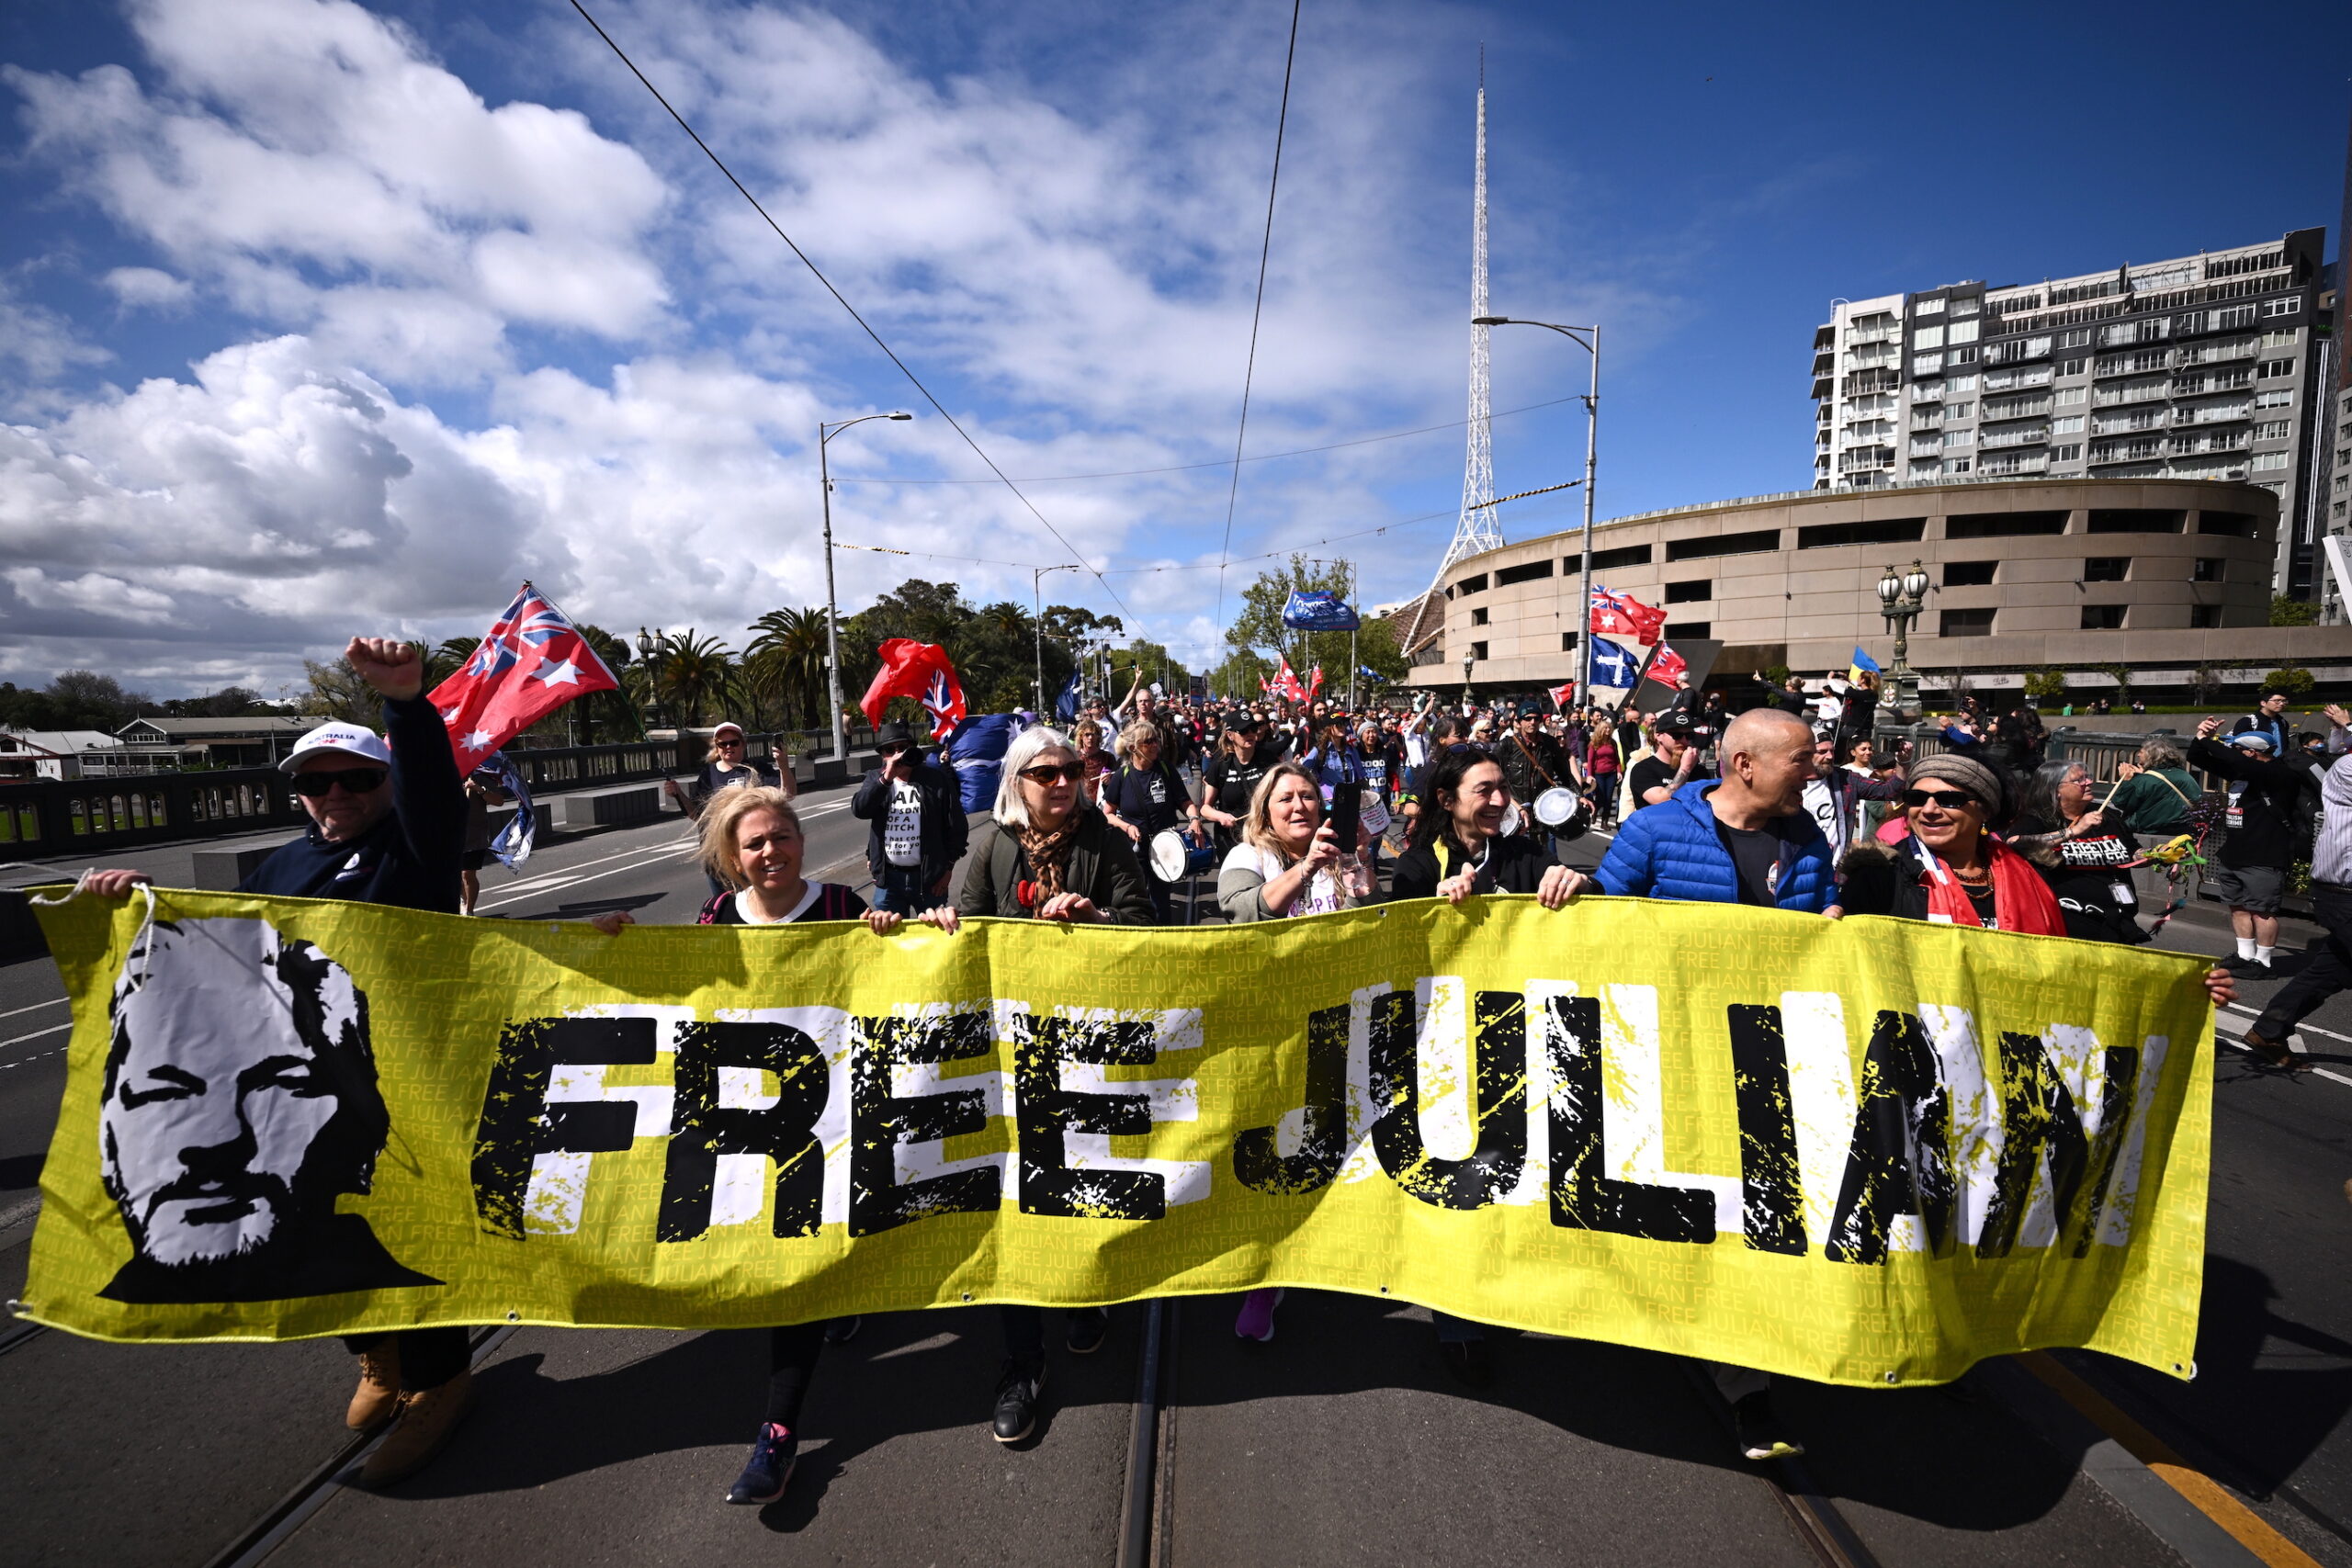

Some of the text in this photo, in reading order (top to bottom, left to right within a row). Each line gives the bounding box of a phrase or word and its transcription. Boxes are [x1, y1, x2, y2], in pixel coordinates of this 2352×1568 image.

[1367, 777, 1386, 786] AD
[891, 790, 922, 805] AN
[345, 914, 425, 938] JULIAN
[436, 925, 477, 945] FREE
[568, 937, 606, 953] FREE
[611, 939, 661, 953] JULIAN
[665, 937, 703, 953] FREE
[771, 937, 813, 954] FREE
[820, 933, 883, 952] JULIAN
[1035, 923, 1365, 957] JULIAN JULIAN FREE JULIAN FREE
[1684, 931, 1752, 952] JULIAN
[1758, 935, 1802, 954] FREE
[385, 939, 435, 961] FREE
[442, 943, 518, 966] JULIAN
[573, 953, 635, 970] JULIAN
[636, 954, 672, 972] FREE
[678, 956, 730, 973] JULIAN
[736, 956, 775, 974] FREE
[781, 953, 844, 974] JULIAN
[1059, 956, 1103, 976] FREE
[1106, 959, 1169, 976] JULIAN
[1176, 959, 1219, 975] FREE
[1224, 953, 1287, 975] JULIAN
[1296, 944, 1332, 964] FREE
[1338, 936, 1391, 959] JULIAN
[773, 975, 816, 992] FREE
[821, 969, 882, 988] JULIAN
[1035, 972, 1094, 991] JULIAN
[1098, 976, 1140, 994] FREE
[1147, 976, 1210, 994] JULIAN
[1216, 976, 1259, 992] FREE
[1263, 967, 1325, 988] JULIAN
[1329, 957, 1366, 976] FREE
[1555, 945, 1597, 964] FREE
[1600, 947, 1669, 968] JULIAN
[1675, 950, 1722, 970] FREE
[1725, 953, 1792, 973] JULIAN
[369, 978, 423, 999] FREE
[432, 982, 510, 1003] JULIAN
[1634, 968, 1802, 993] FREE JULIAN FREE
[1111, 992, 1170, 1010] JULIAN
[1177, 993, 1219, 1010] FREE
[1224, 988, 1287, 1009] JULIAN
[1292, 981, 1333, 1001] FREE
[1674, 990, 1721, 1010] FREE
[2024, 982, 2066, 1003] FREE
[414, 1001, 469, 1021] FREE
[1215, 1003, 1322, 1024] FREE JULIAN
[1984, 997, 2021, 1019] FREE
[1226, 1022, 1286, 1040] JULIAN
[406, 1041, 461, 1061] FREE
[410, 1063, 492, 1081] JULIAN
[399, 1083, 448, 1101] FREE
[1217, 1077, 1258, 1093] FREE
[471, 976, 2168, 1266] FREE JULIAN
[403, 1122, 442, 1143] FREE
[413, 1187, 451, 1207] FREE
[418, 1224, 457, 1242] FREE
[606, 1225, 651, 1243] FREE
[1227, 1213, 1285, 1233] JULIAN
[1335, 1215, 1396, 1235] JULIAN
[699, 1241, 766, 1261] JULIAN
[772, 1240, 811, 1258] FREE
[902, 1230, 960, 1250] JULIAN
[660, 1263, 726, 1283] JULIAN
[735, 1261, 776, 1280] FREE
[890, 1252, 932, 1268] FREE
[1047, 1254, 1101, 1271] JULIAN
[1515, 1240, 1560, 1261] FREE
[1566, 1247, 1639, 1275] JULIAN
[1646, 1260, 1697, 1283] FREE
[899, 1269, 960, 1288] JULIAN
[1611, 1277, 1687, 1304] JULIAN
[1693, 1286, 1747, 1314] FREE
[1752, 1296, 1837, 1327] JULIAN
[1570, 1290, 1849, 1356] JULIAN FREE FREE
